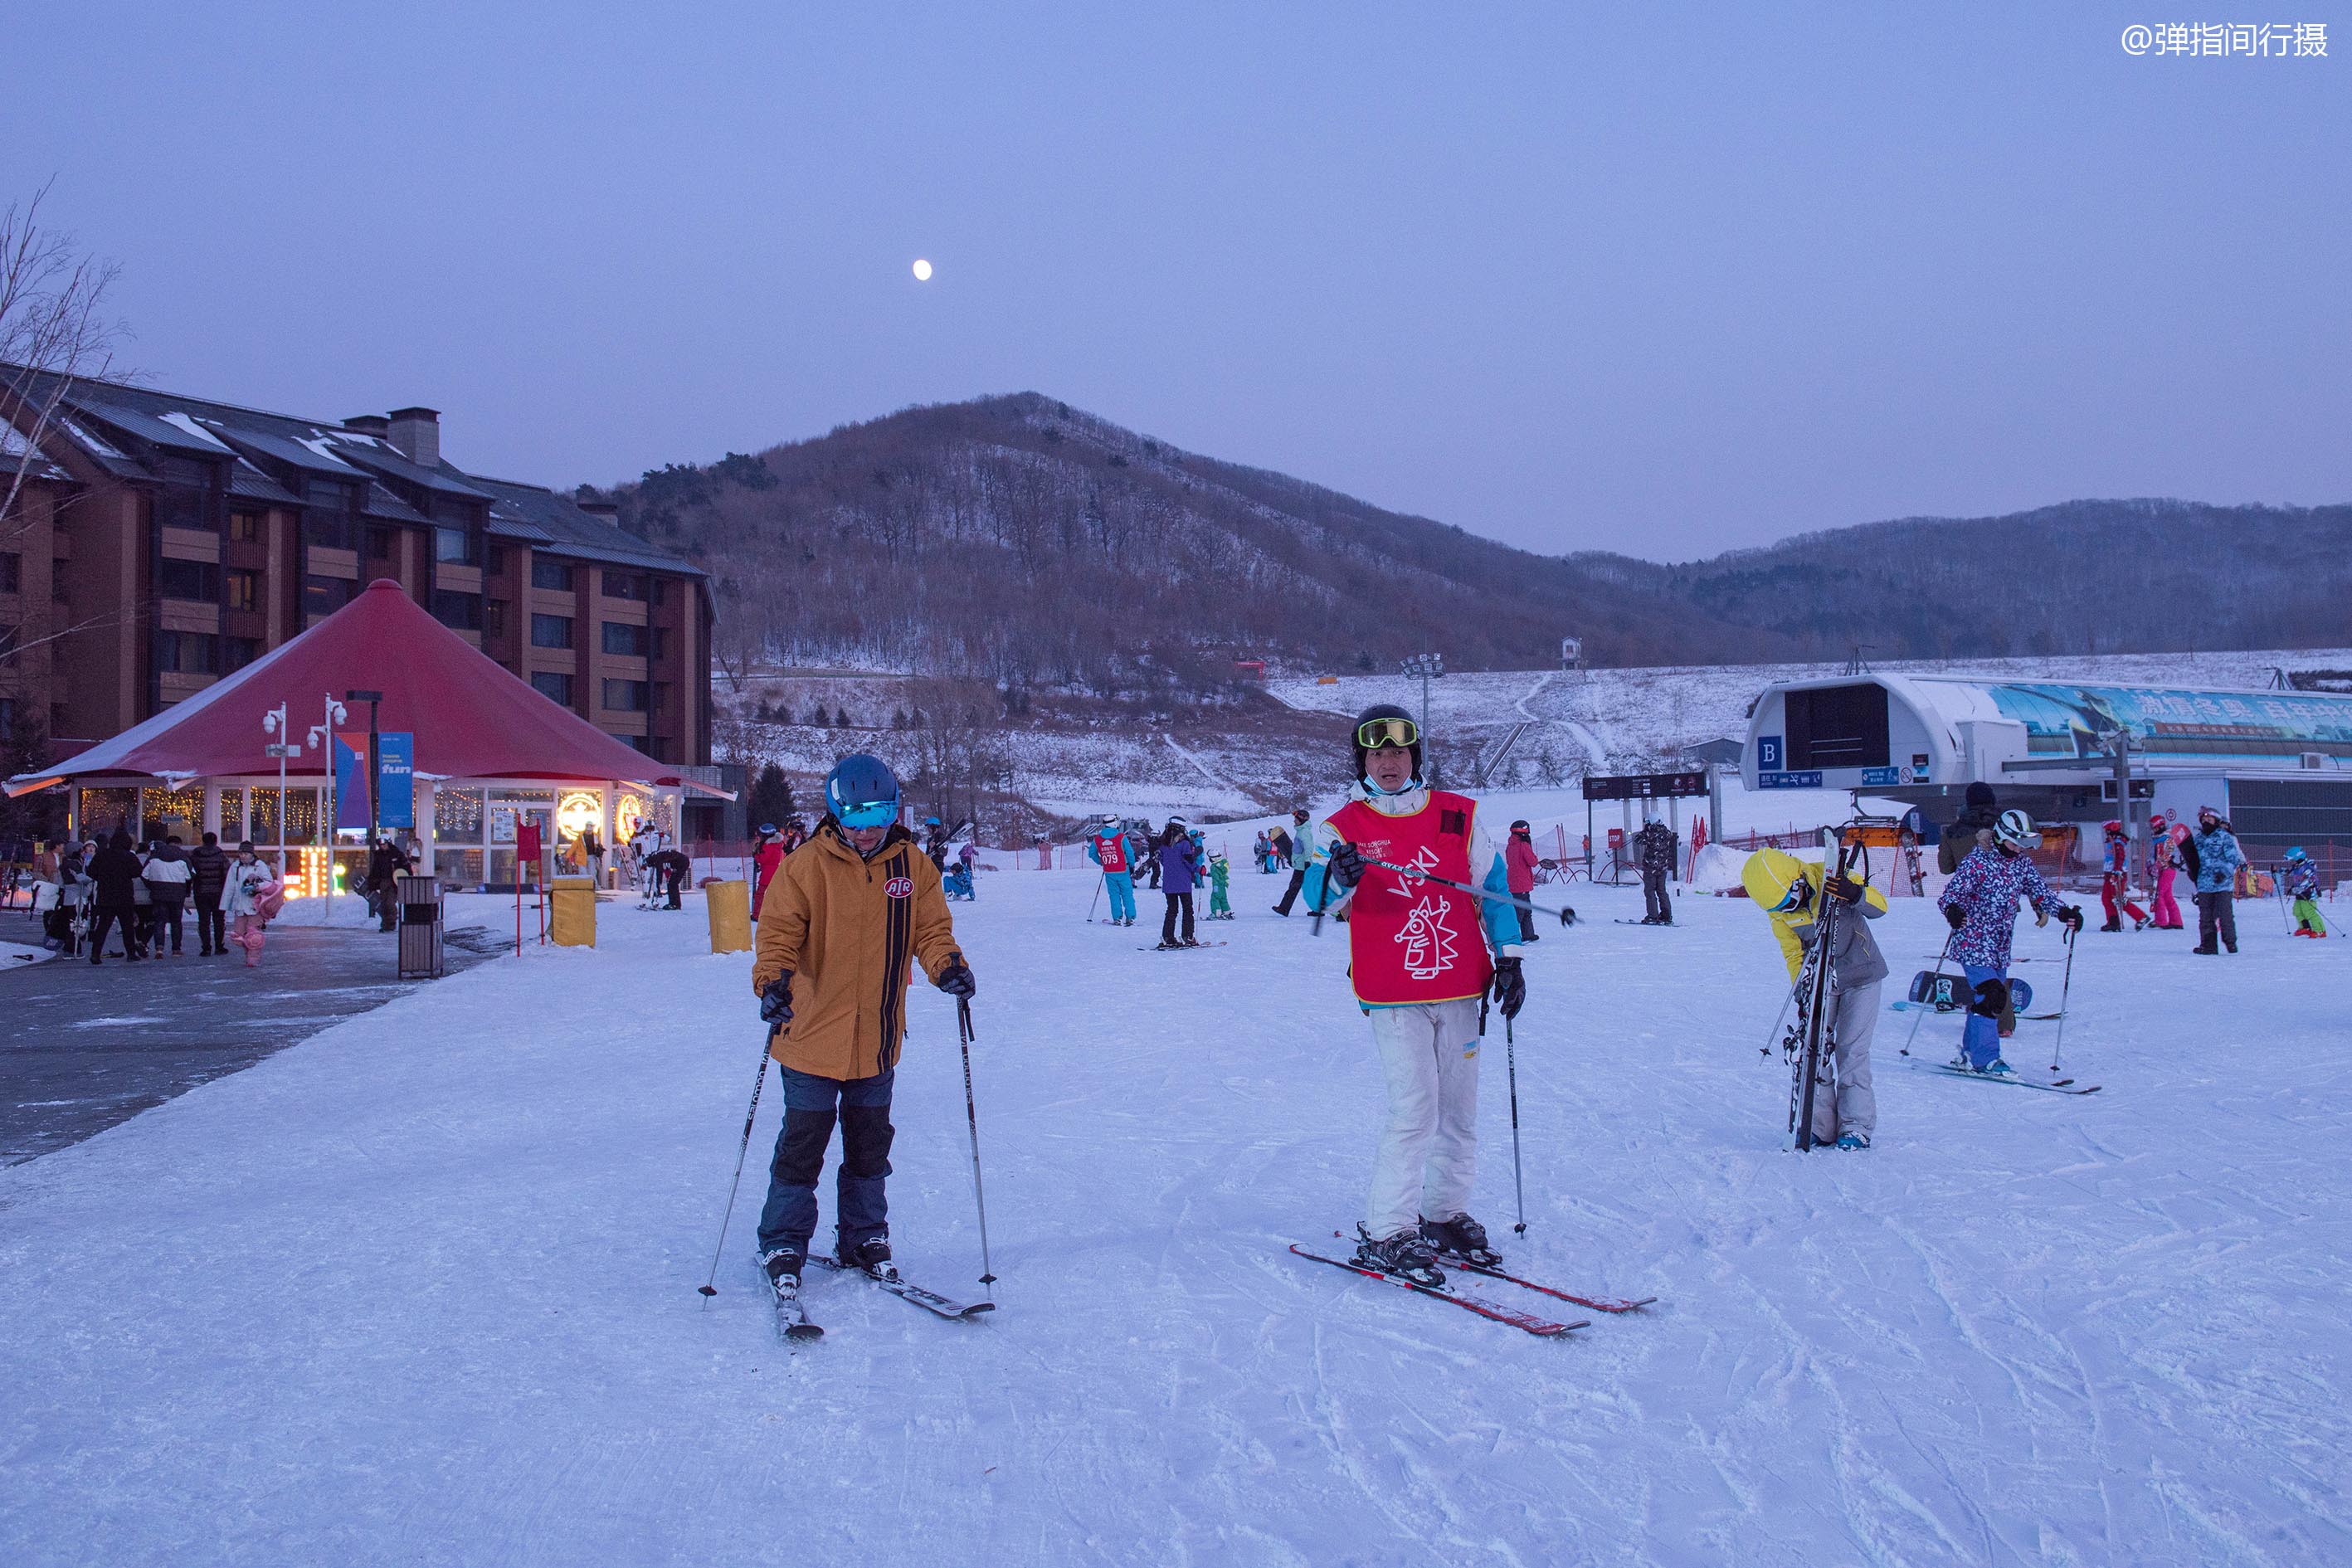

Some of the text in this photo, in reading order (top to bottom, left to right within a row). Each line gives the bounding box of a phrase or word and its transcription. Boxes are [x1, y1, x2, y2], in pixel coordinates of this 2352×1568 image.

[1763, 743, 1775, 762] B
[382, 764, 411, 773] fun
[1102, 854, 1118, 864] 079
[887, 879, 911, 896] AIR
